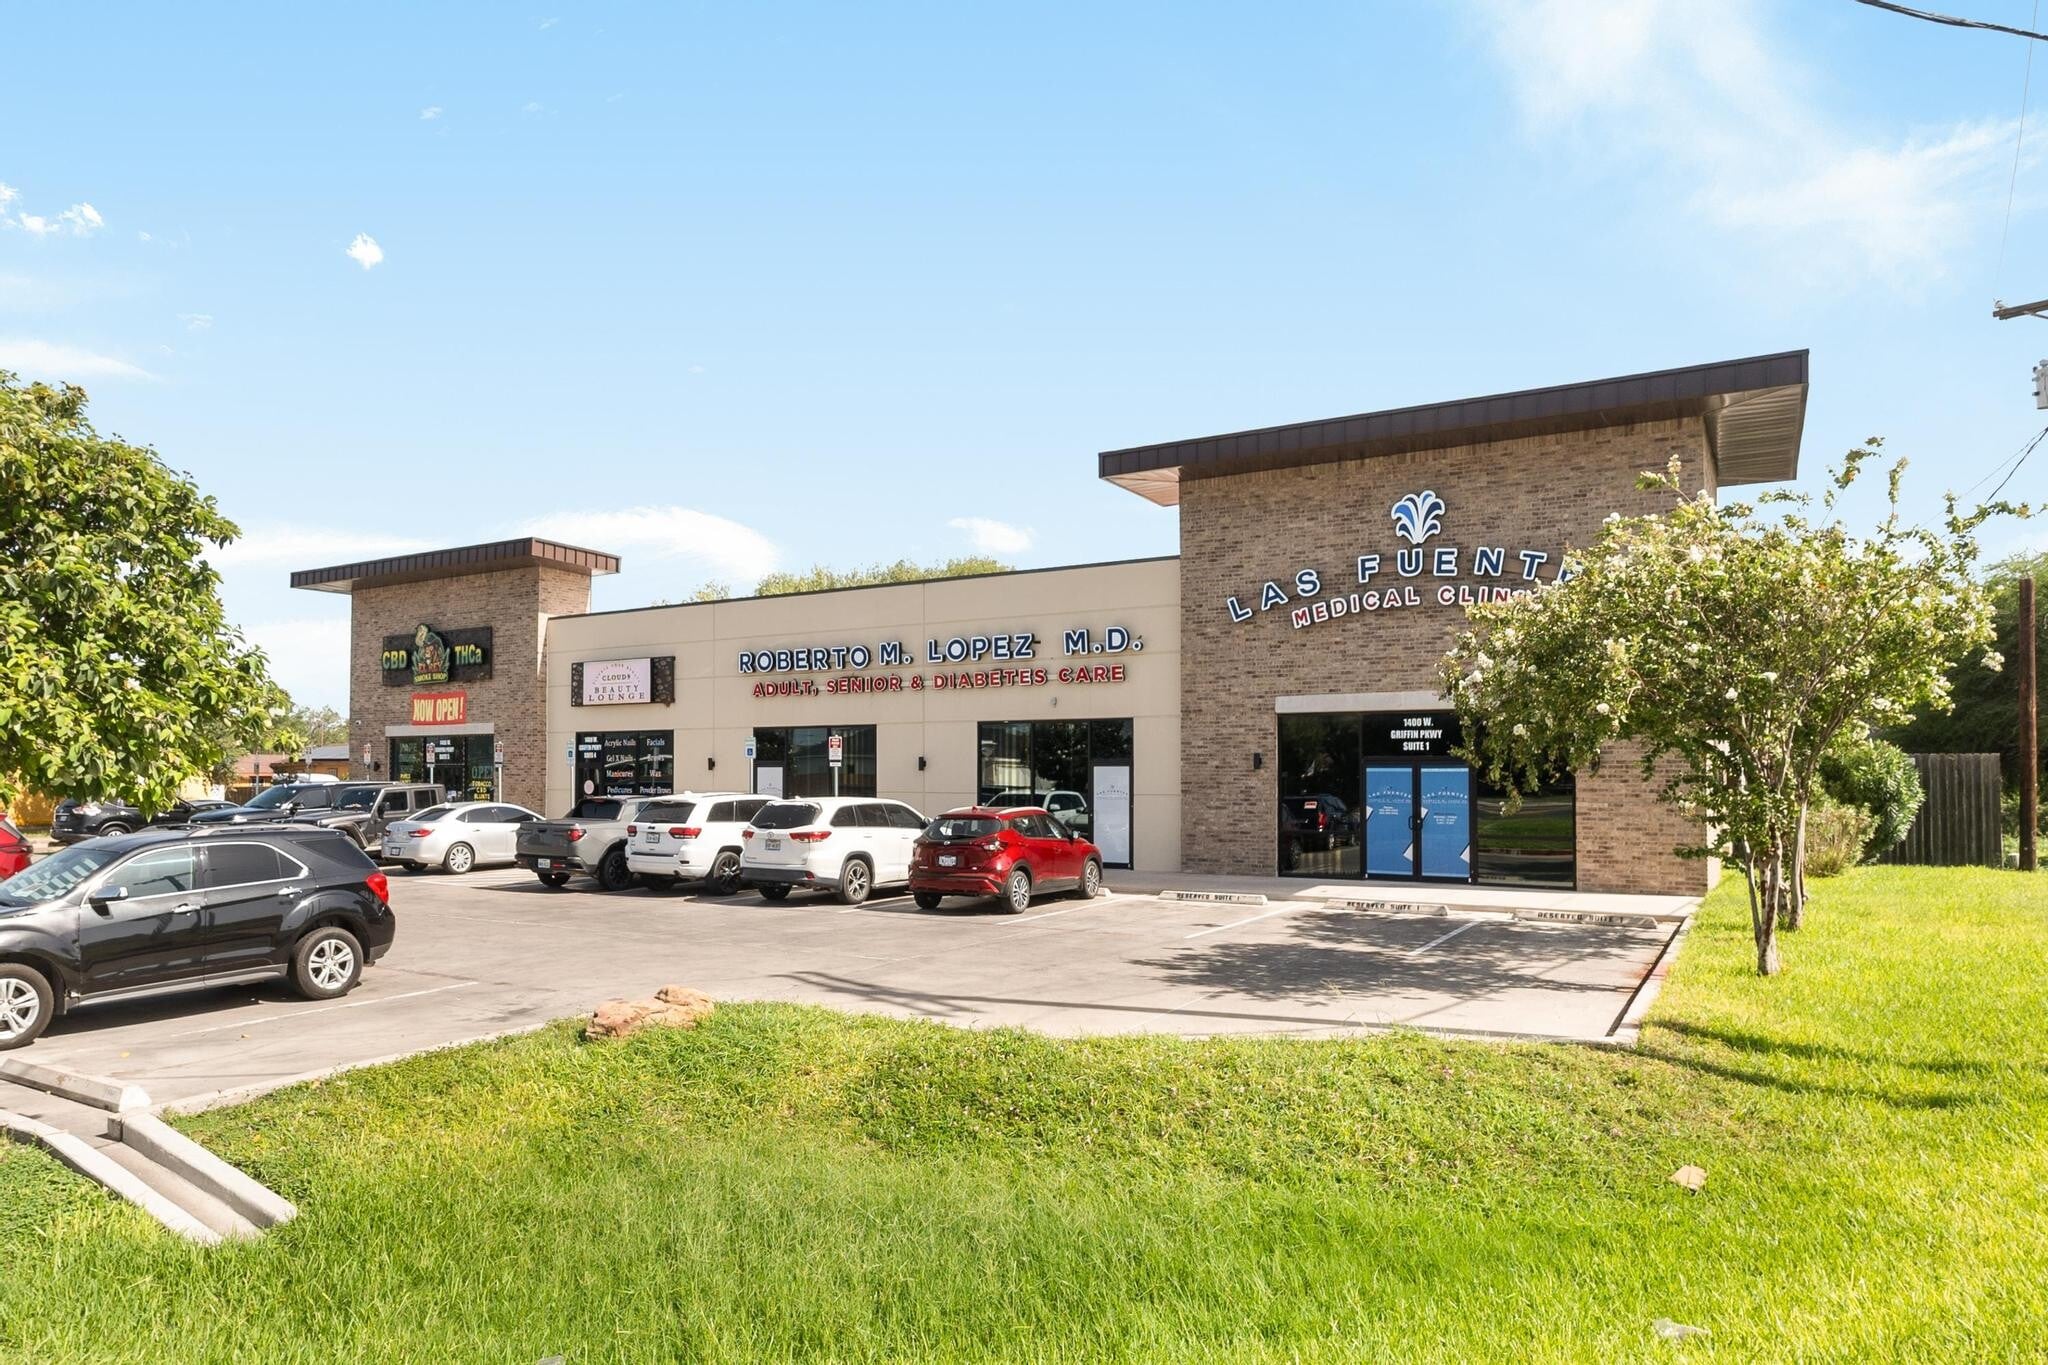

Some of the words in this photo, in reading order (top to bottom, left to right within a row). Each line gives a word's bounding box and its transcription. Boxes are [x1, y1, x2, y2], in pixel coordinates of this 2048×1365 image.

[1227, 569, 1320, 623] LAS
[1358, 547, 1584, 584] FUENT
[1292, 586, 1421, 629] MEDICAL
[1438, 585, 1526, 605] CLIN
[738, 645, 869, 673] ROBERTO
[879, 641, 912, 665] M.
[927, 633, 1034, 663] LOPEZ
[1063, 626, 1142, 655] M.D.
[382, 650, 407, 670] CBD
[753, 680, 818, 697] ADULT,
[826, 675, 901, 694] SENIOR
[910, 674, 923, 690] &
[932, 667, 1047, 690] DIABETES
[1058, 664, 1125, 683] CARE
[594, 684, 639, 694] BEAUTY
[588, 692, 645, 702] LOUNGE
[413, 698, 434, 722] NOW
[436, 697, 464, 721] OPEN!
[1403, 718, 1422, 727] 1400
[1423, 717, 1434, 727] W.
[1390, 730, 1419, 739] GRIFFIN
[1420, 729, 1442, 739] PKWY
[1402, 741, 1424, 751] SUITE
[1346, 901, 1385, 909] RESERVED
[1537, 912, 1582, 920] RESERVED
